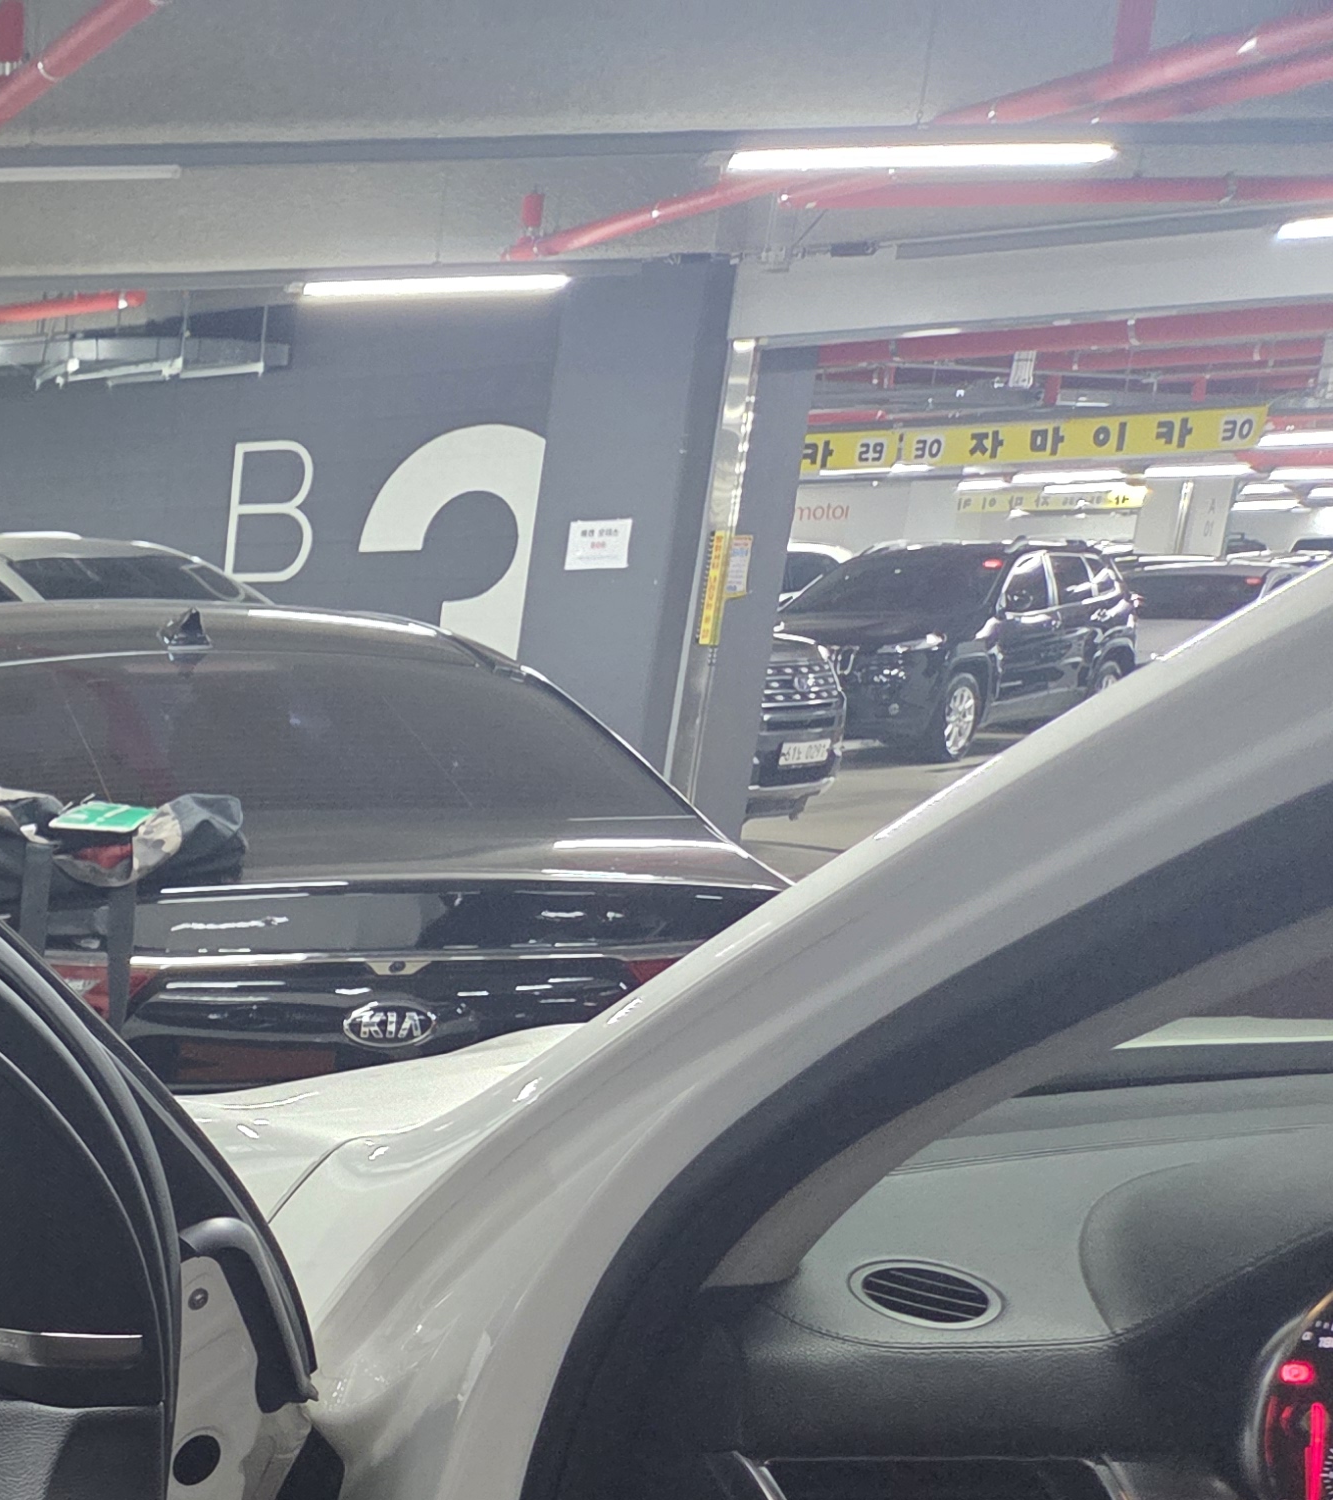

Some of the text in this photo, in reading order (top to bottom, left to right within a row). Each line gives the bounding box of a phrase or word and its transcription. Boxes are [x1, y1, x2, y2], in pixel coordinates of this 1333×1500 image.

[857, 441, 884, 463] 29
[913, 438, 942, 460] 30
[1221, 417, 1254, 442] 30
[359, 1011, 422, 1038] KIA
